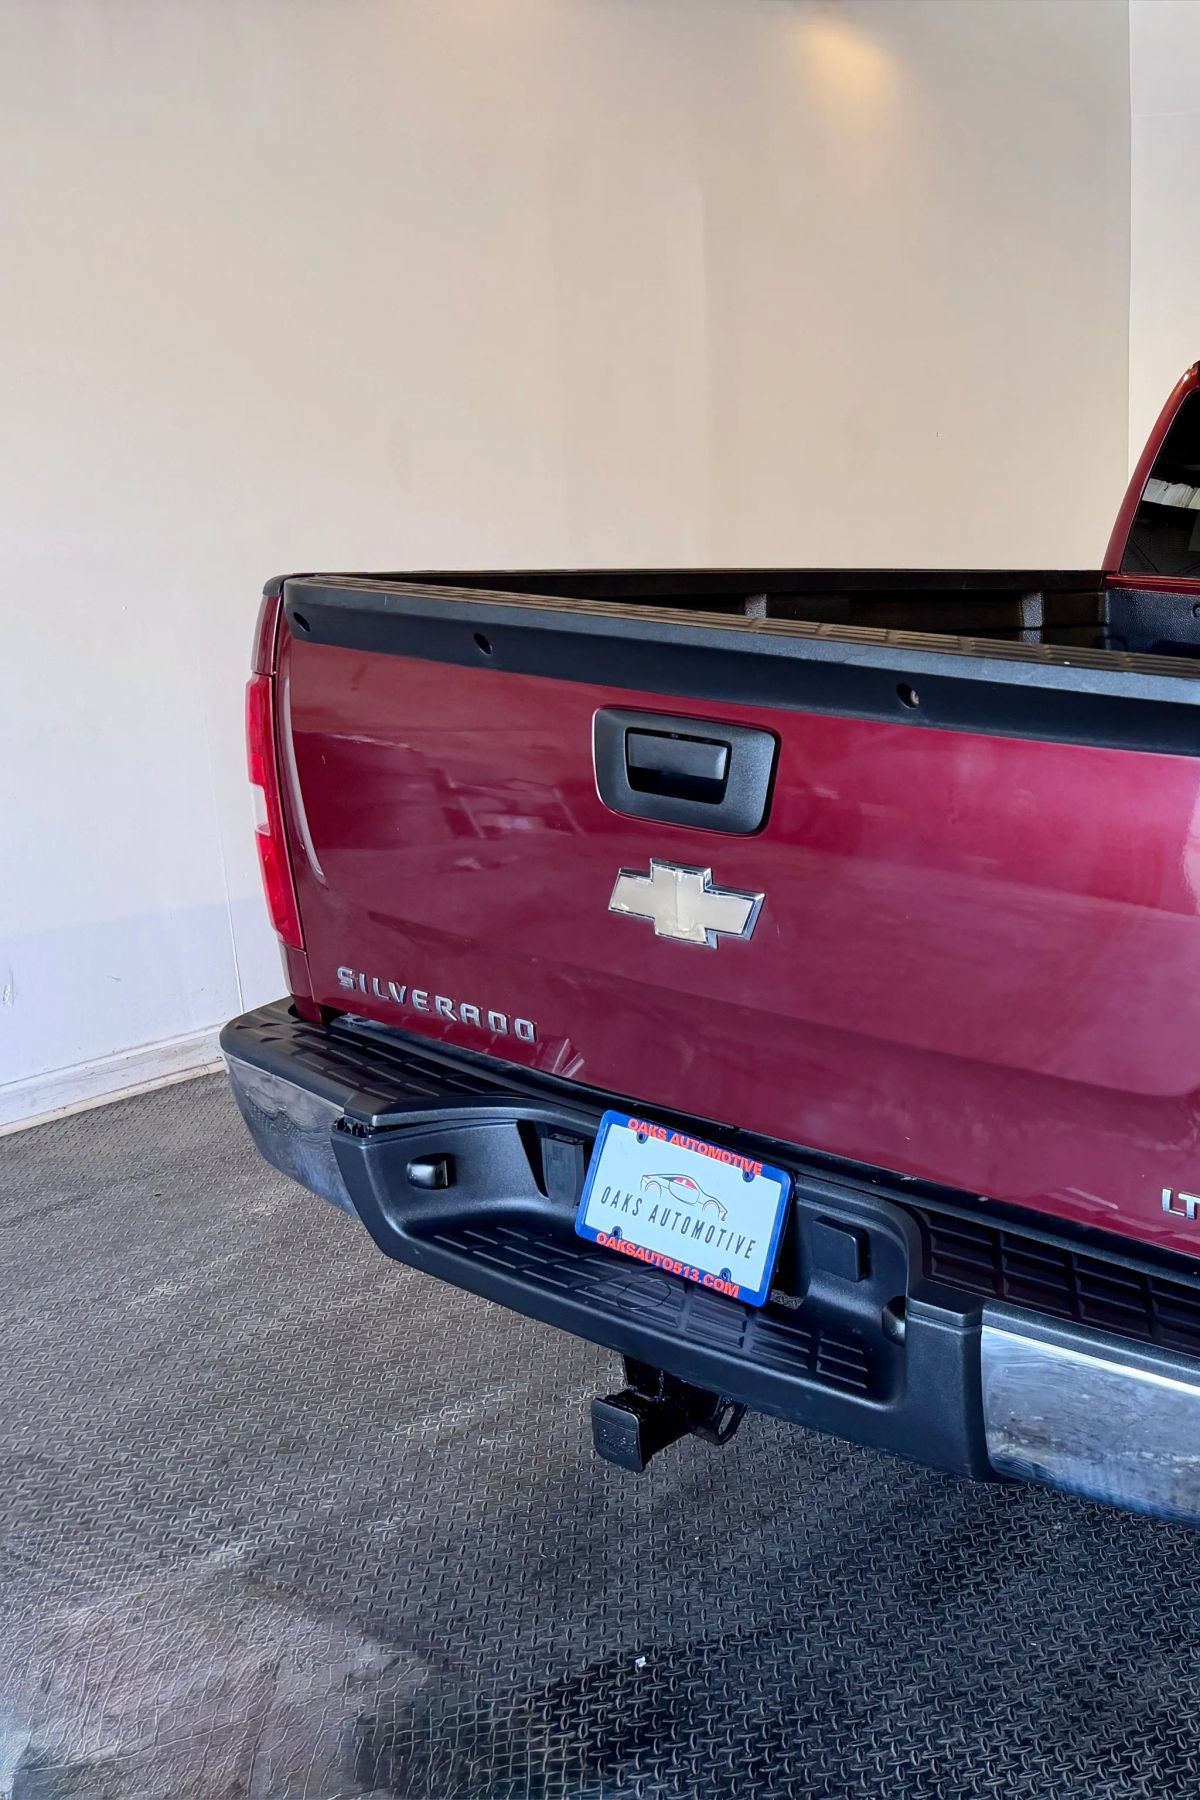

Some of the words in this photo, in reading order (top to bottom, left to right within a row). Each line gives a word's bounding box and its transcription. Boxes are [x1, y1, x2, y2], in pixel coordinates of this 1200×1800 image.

[337, 966, 537, 1042] SILVERADO
[627, 1118, 667, 1141] OAKS
[669, 1134, 763, 1175] AUTOMOTIVE
[601, 1186, 643, 1216] OAKS
[648, 1204, 756, 1259] AUTOMOTIVE
[596, 1232, 740, 1297] OAKSAUTO513.COM
